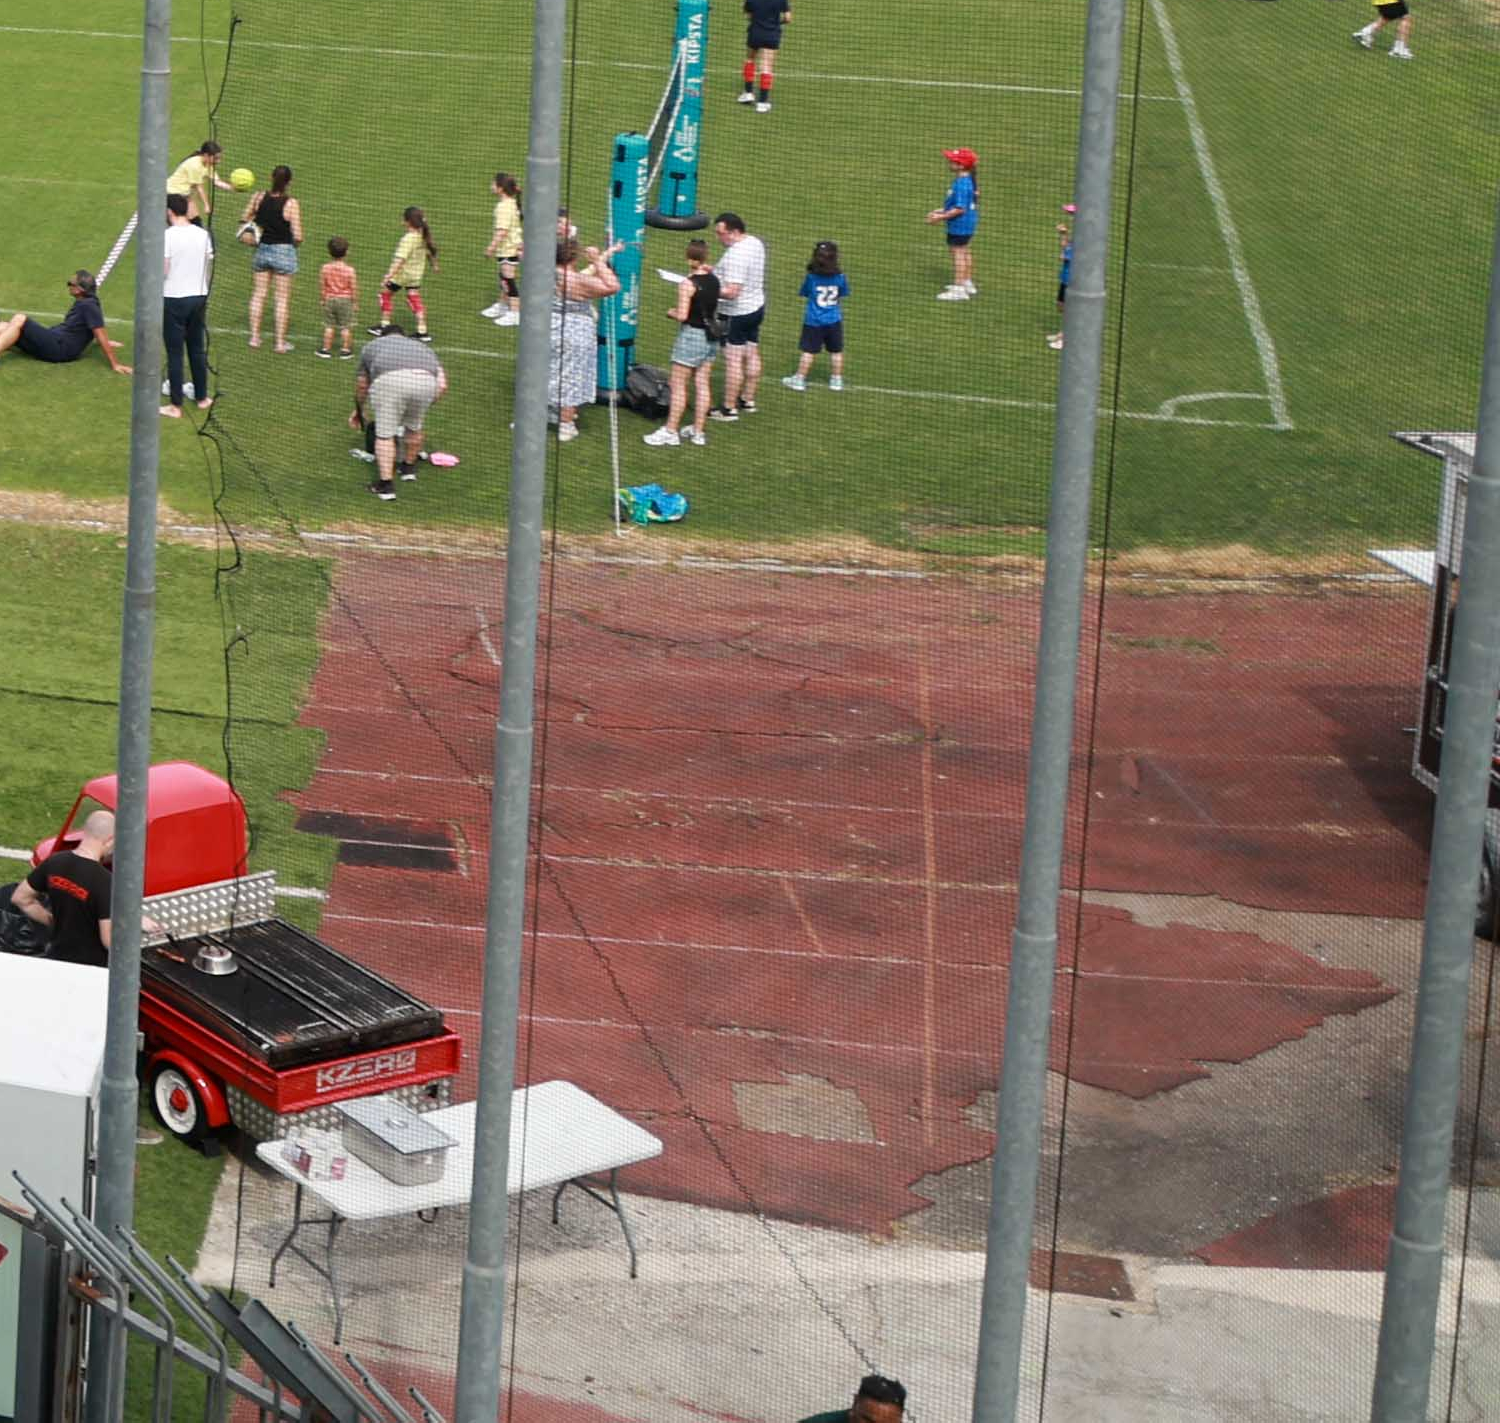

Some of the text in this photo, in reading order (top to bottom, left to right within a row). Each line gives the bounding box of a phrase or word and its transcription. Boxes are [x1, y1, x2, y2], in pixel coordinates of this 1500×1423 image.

[687, 13, 702, 64] KIPSTA
[634, 156, 648, 214] KIPSTA
[816, 285, 838, 307] 22
